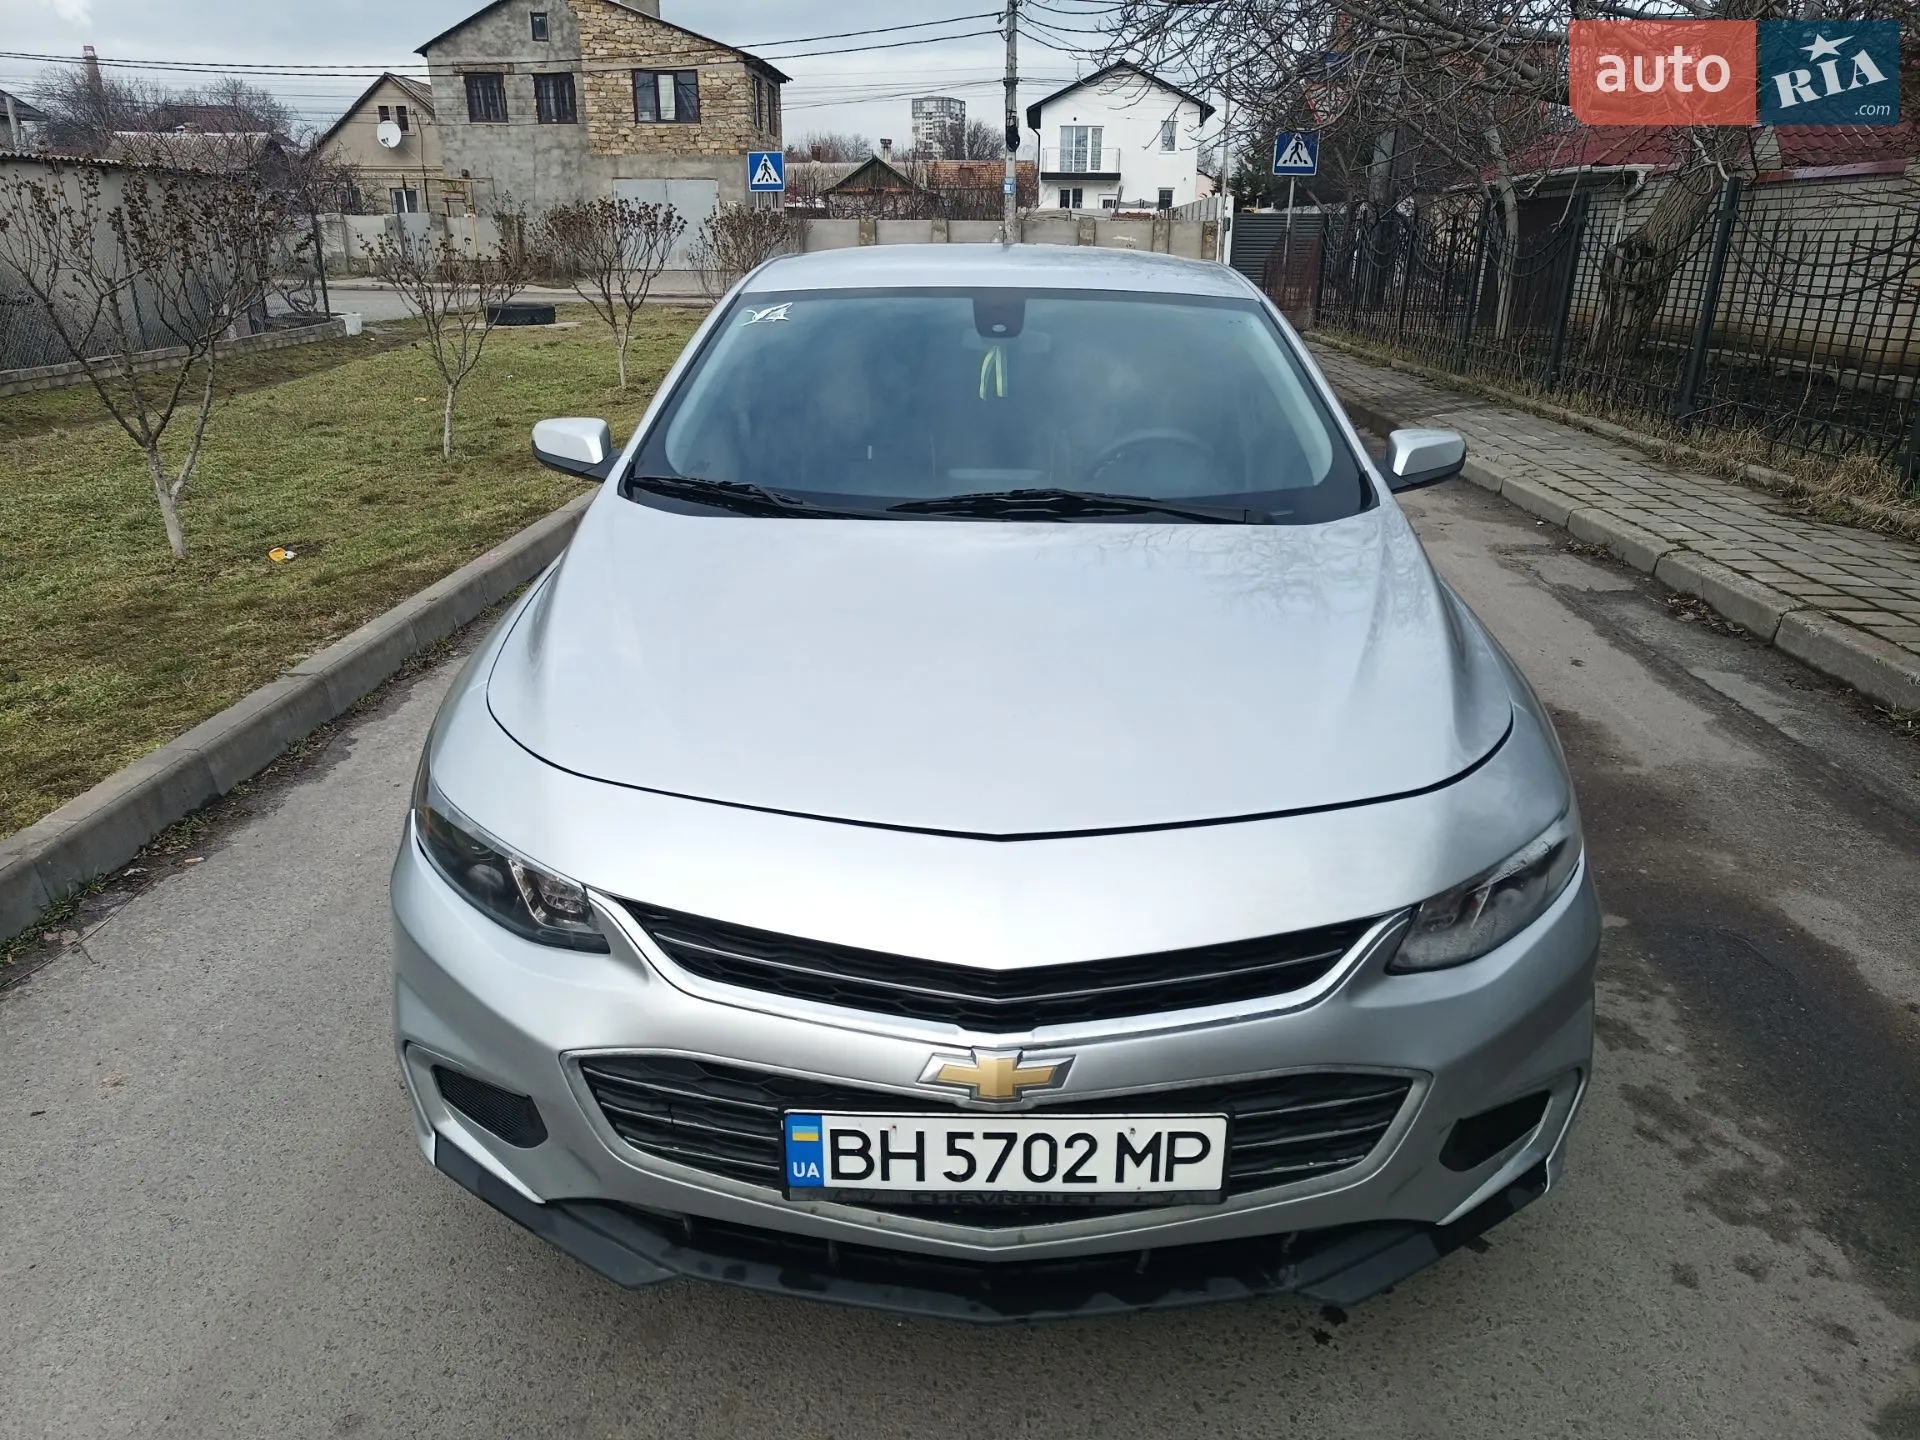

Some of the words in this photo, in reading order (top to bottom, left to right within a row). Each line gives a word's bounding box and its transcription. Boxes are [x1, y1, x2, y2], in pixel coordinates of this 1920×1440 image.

[793, 1162, 820, 1179] UA
[830, 1129, 925, 1182] BH
[943, 1132, 1098, 1183] 5702
[1114, 1131, 1212, 1183] MP
